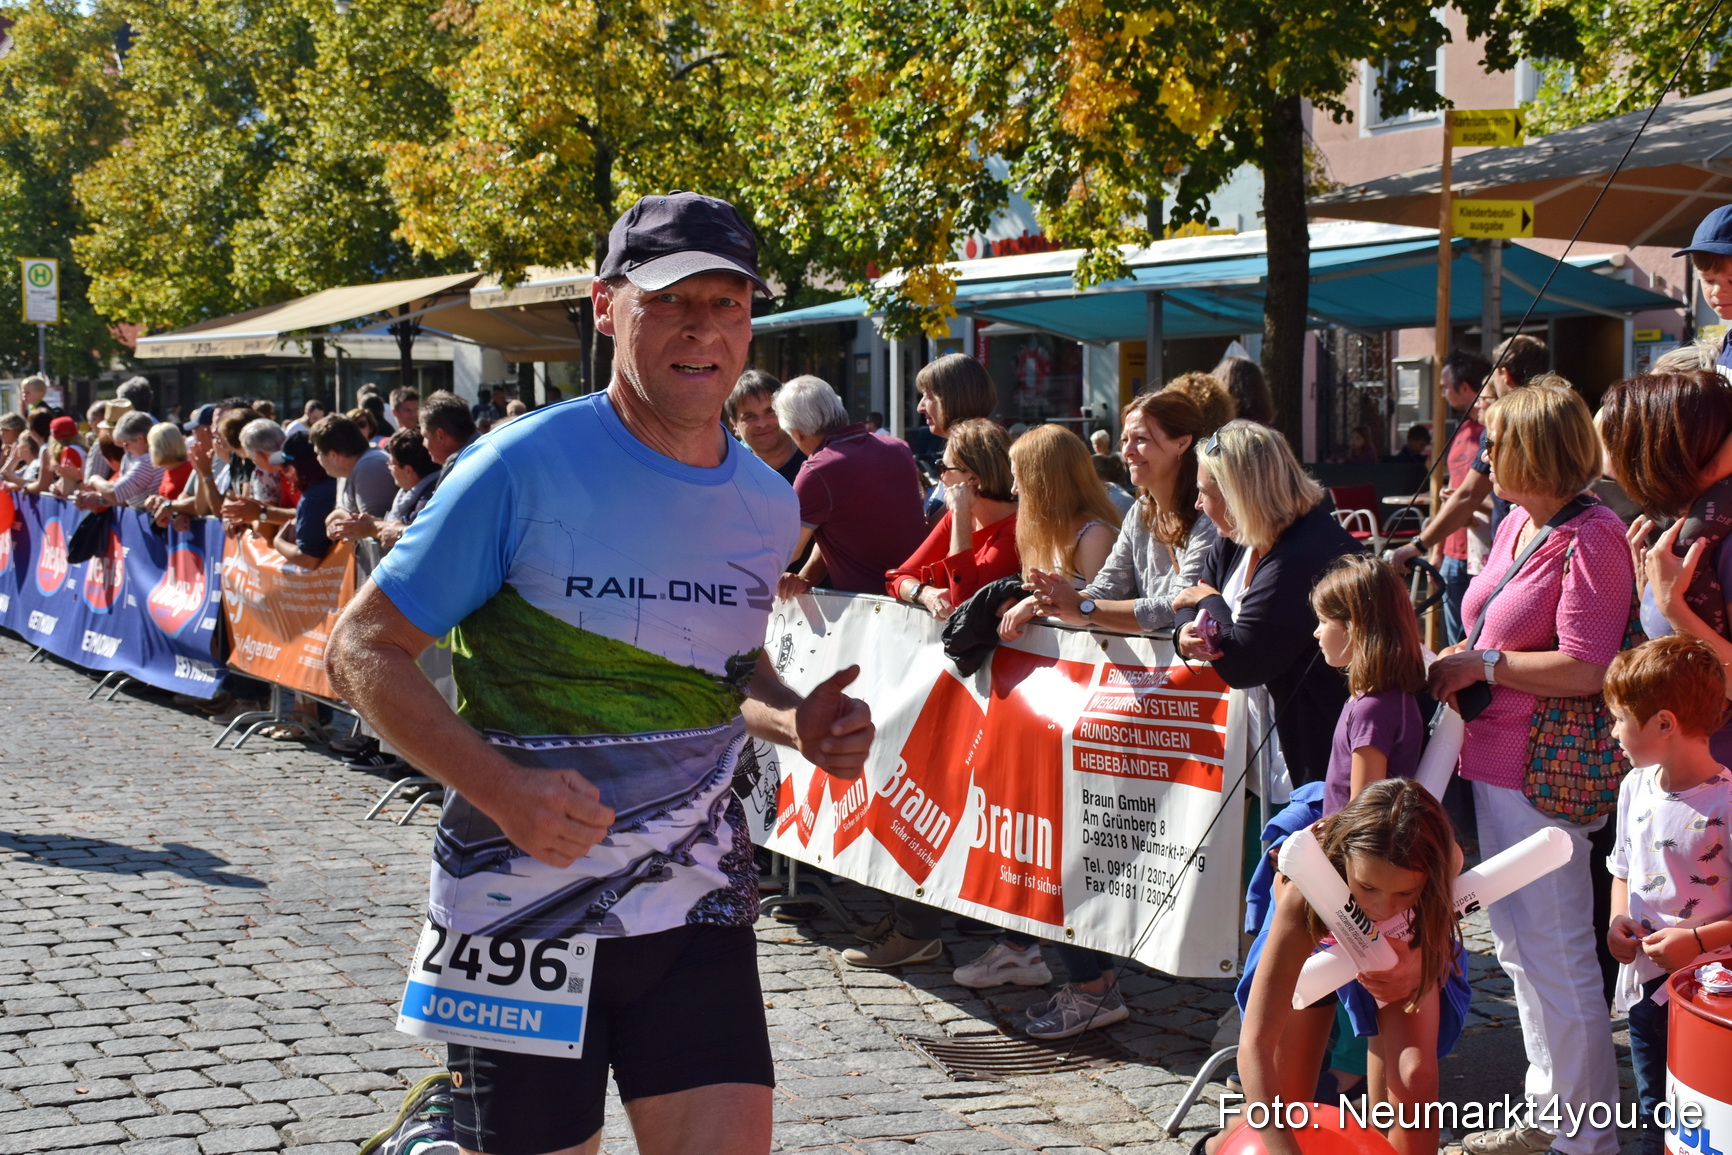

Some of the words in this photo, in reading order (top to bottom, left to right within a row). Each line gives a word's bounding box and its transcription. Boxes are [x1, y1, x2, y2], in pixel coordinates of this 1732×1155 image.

[1462, 131, 1497, 144] ausgabe
[1459, 206, 1516, 219] Kleiderbeutel-
[1470, 221, 1504, 234] ausgabe
[242, 634, 282, 661] Agentur
[1107, 668, 1173, 685] BINDESTRICKE
[1090, 695, 1200, 718] VERZURRSYSTEME
[1079, 722, 1191, 749] RUNDSCHLINGEN
[1080, 752, 1169, 778] HEBEBÄNDER
[833, 777, 866, 831] Braun
[876, 754, 951, 850] Braun
[1082, 789, 1114, 809] Braun
[1118, 795, 1156, 813] GmbH
[970, 785, 1053, 870] Braun
[1082, 809, 1099, 826] Am
[1102, 812, 1157, 838] Grünberg
[1160, 820, 1166, 835] 8
[890, 819, 911, 842] Sicher
[908, 838, 920, 851] ist
[917, 848, 937, 868] sicher
[1082, 829, 1128, 849] D-92318
[1000, 865, 1021, 886] Sicher
[1025, 872, 1036, 889] ist
[1037, 875, 1063, 896] sicher
[1083, 857, 1105, 874] Tel.
[1107, 860, 1138, 880] 09181
[1141, 865, 1145, 881] /
[1147, 867, 1175, 888] 2307-0
[1085, 876, 1105, 893] Fax
[1108, 880, 1137, 900] 09181
[1140, 886, 1145, 901] /
[422, 924, 570, 991] 2496
[576, 946, 585, 956] D
[422, 994, 543, 1032] JOCHEN
